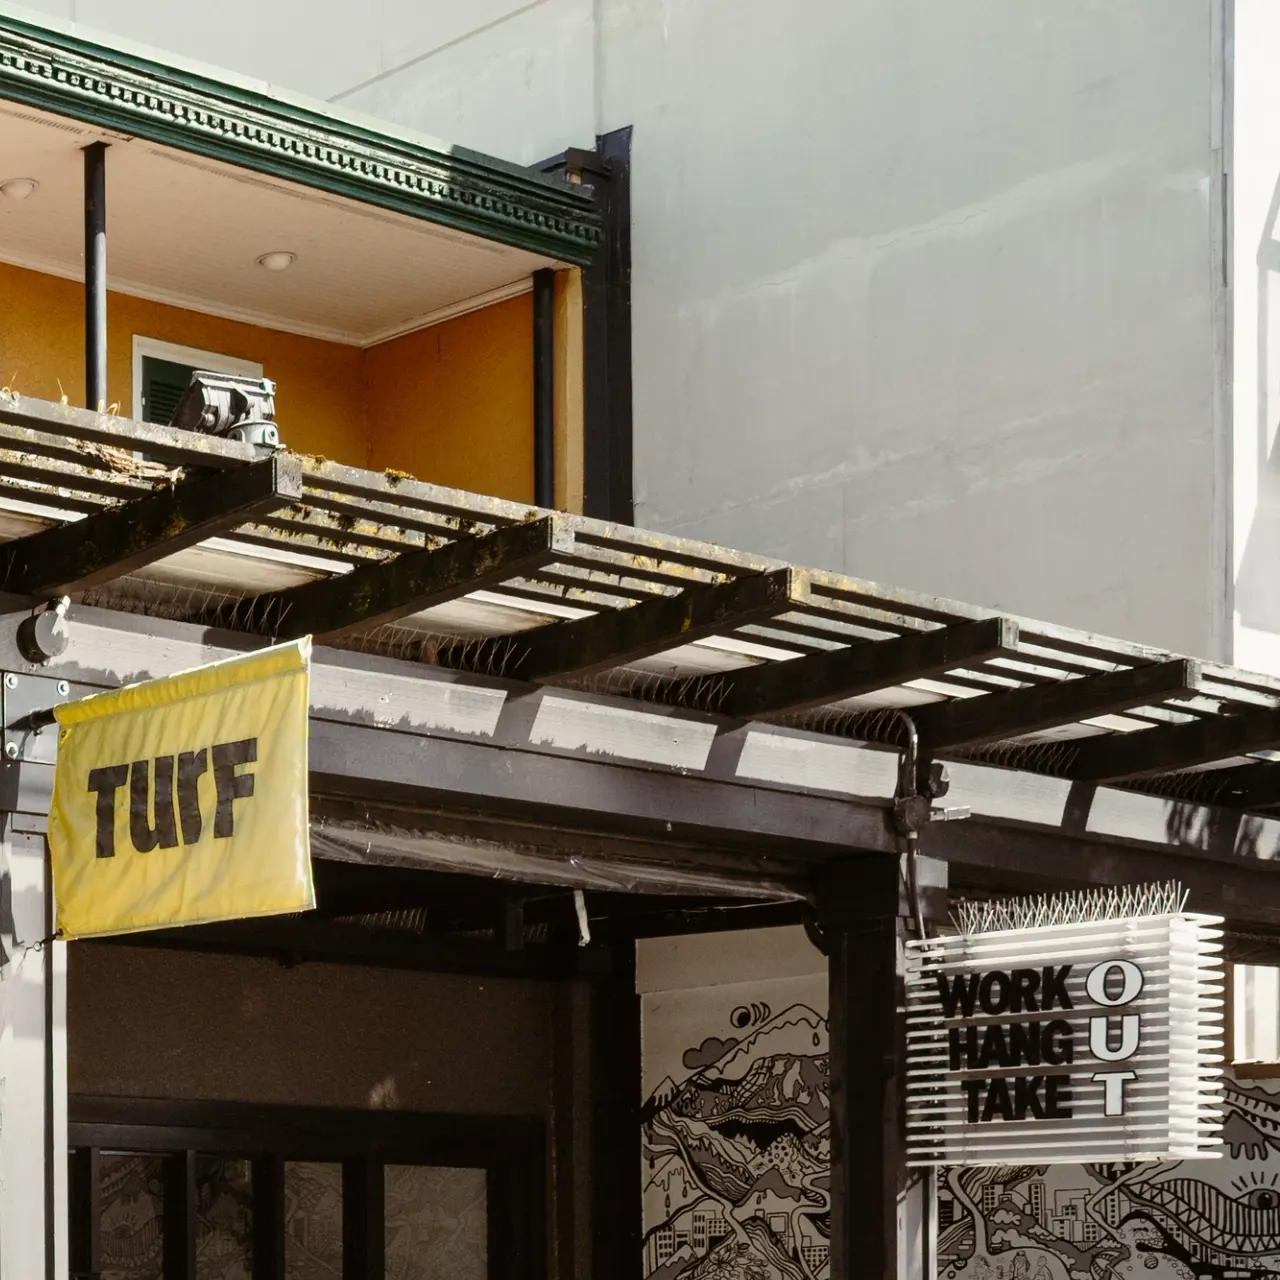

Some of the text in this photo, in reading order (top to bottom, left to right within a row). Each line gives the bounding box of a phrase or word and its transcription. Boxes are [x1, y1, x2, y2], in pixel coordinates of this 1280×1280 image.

[938, 964, 1074, 1018] WORK
[948, 1019, 1074, 1071] HANG
[1085, 958, 1144, 1117] OUT
[961, 1075, 1073, 1123] TAKE
